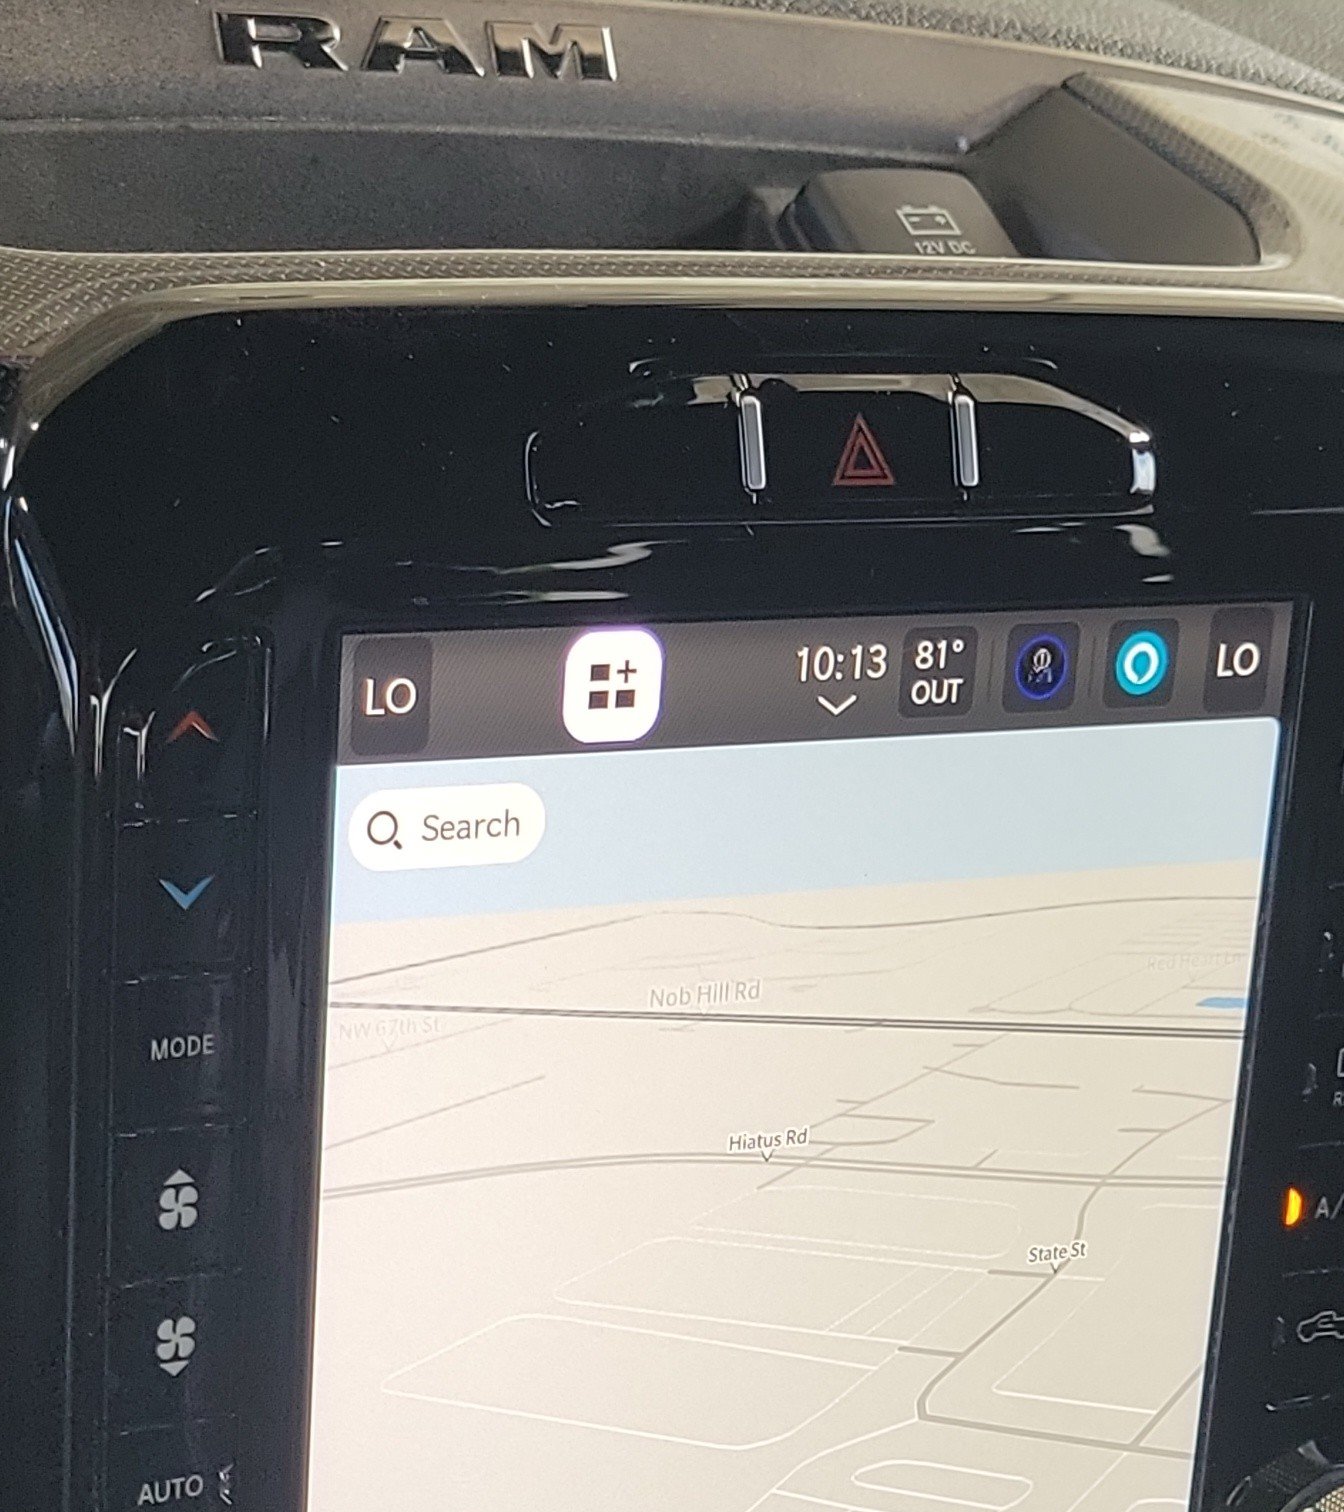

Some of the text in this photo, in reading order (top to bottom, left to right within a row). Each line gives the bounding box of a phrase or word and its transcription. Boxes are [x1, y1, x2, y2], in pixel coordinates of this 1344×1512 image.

[214, 9, 619, 82] RAM
[914, 239, 976, 255] 12V DC
[796, 644, 889, 683] 10:13
[914, 639, 965, 671] 81°
[1216, 641, 1260, 678] LO
[364, 676, 418, 717] LO
[910, 678, 964, 705] OUT
[421, 809, 521, 843] Search
[1146, 955, 1177, 971] Red
[649, 978, 762, 1009] Nob Hill Rd
[338, 1015, 441, 1041] NW 67th St
[149, 1034, 215, 1062] MODE
[728, 1126, 808, 1152] Hiatus Rd
[1029, 1242, 1086, 1262] State St
[137, 1473, 205, 1506] AUTO
